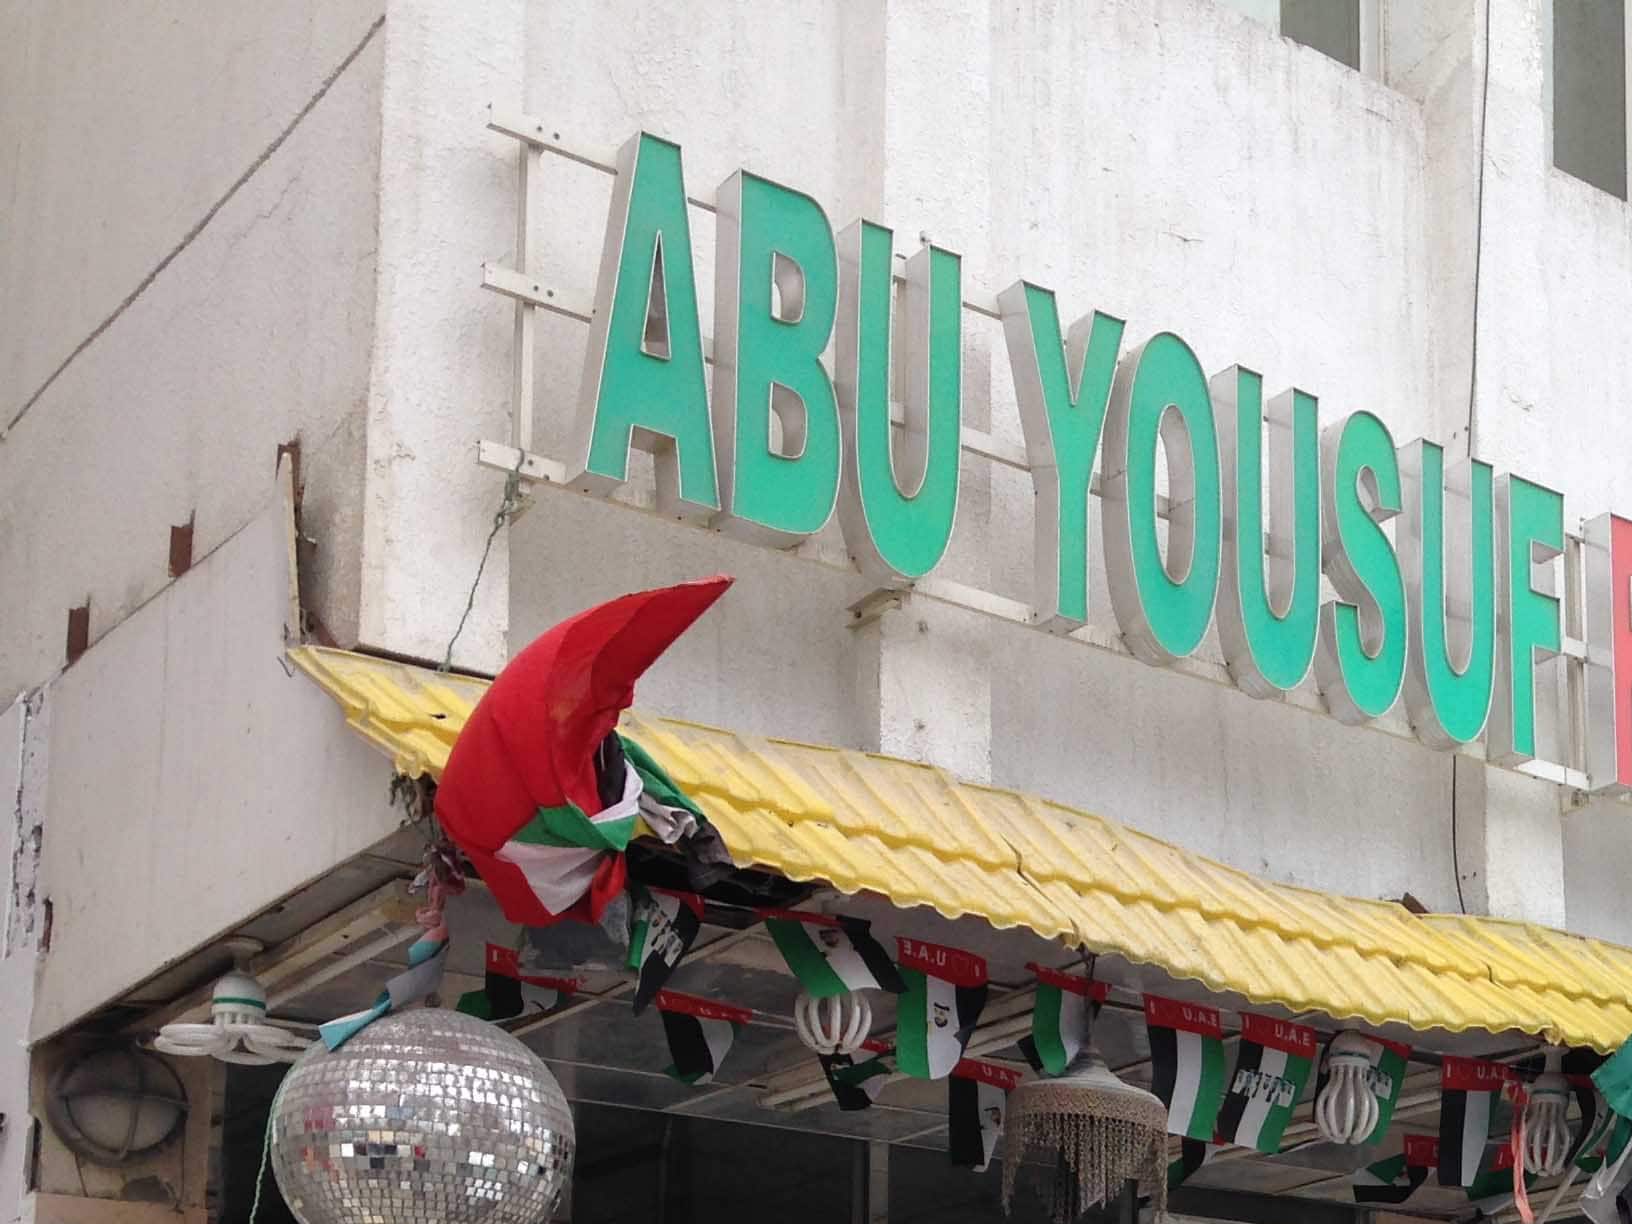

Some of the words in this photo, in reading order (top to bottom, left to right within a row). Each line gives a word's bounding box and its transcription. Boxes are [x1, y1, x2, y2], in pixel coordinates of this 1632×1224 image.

[584, 130, 963, 580] ABU
[1015, 279, 1566, 759] YOUSUF
[1181, 1007, 1218, 1027] U.A.E
[1274, 1023, 1312, 1046] U.A.E
